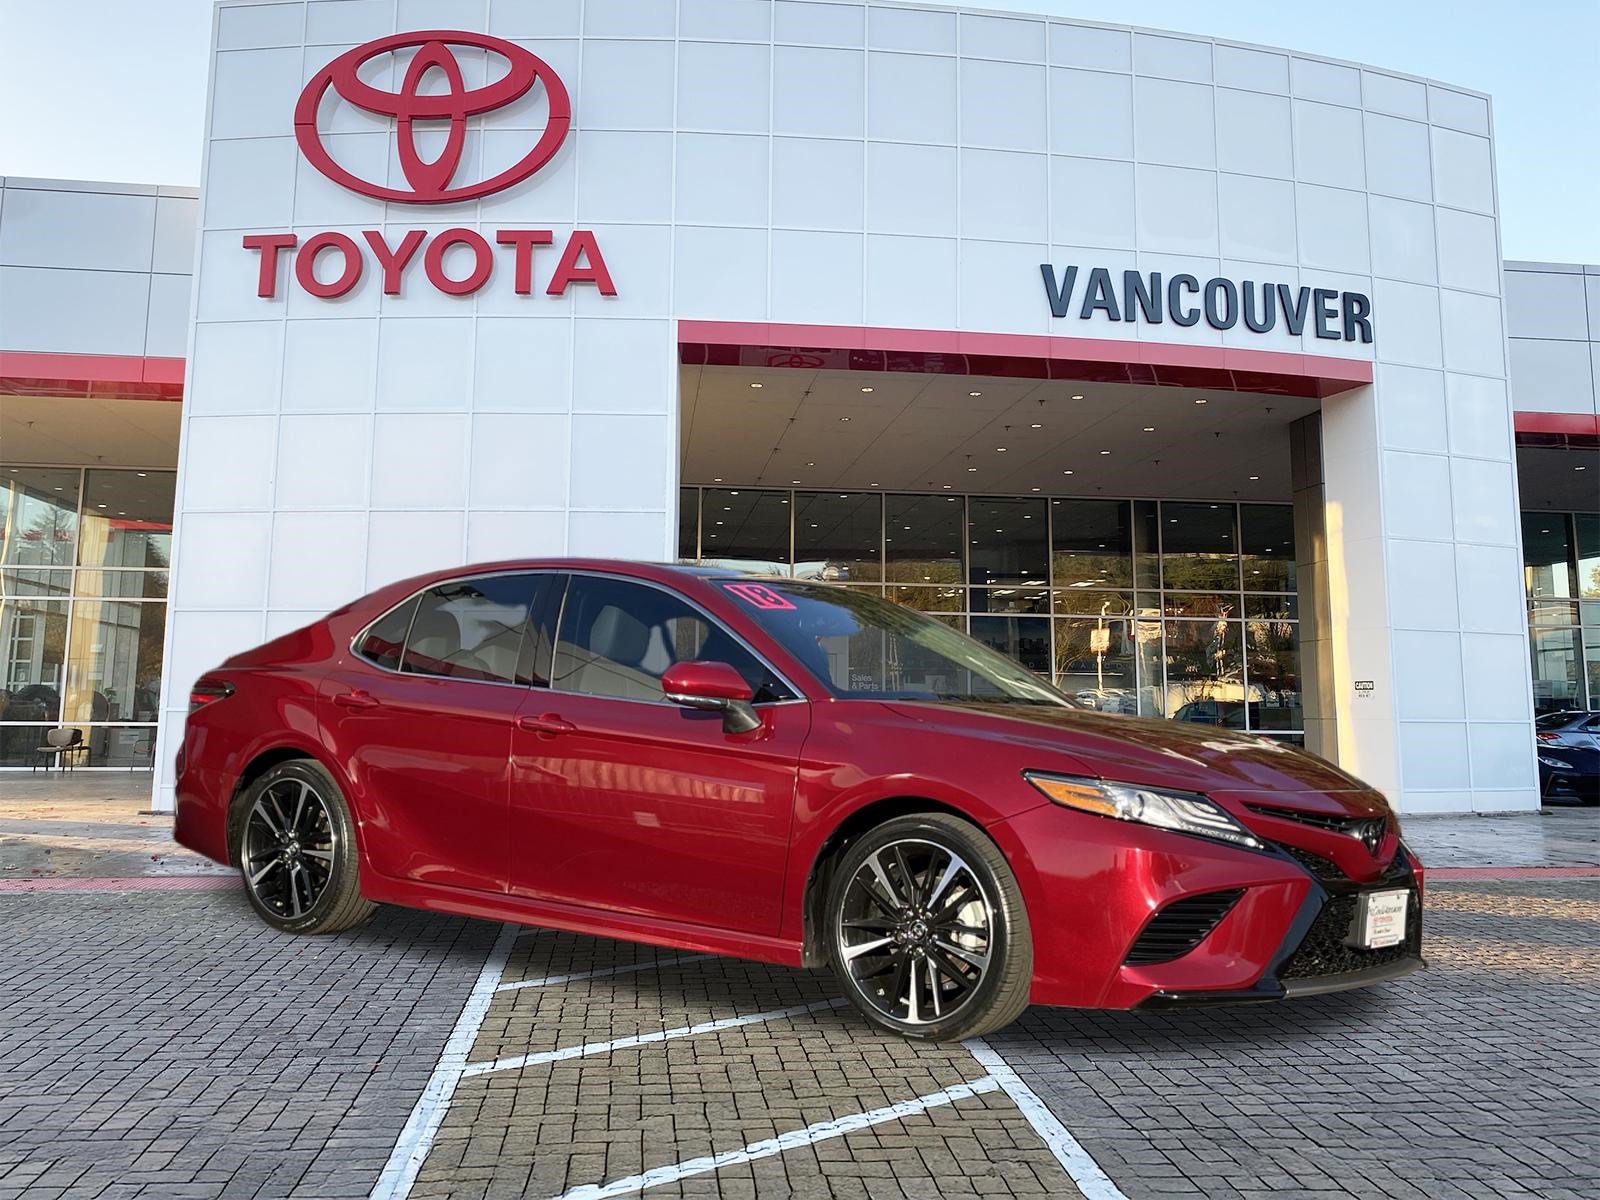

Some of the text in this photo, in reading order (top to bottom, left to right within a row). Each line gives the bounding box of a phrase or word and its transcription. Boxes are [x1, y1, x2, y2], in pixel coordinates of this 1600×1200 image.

[242, 228, 617, 299] TOYOTA
[1040, 264, 1373, 343] VANCOUVER
[851, 673, 873, 682] Sales
